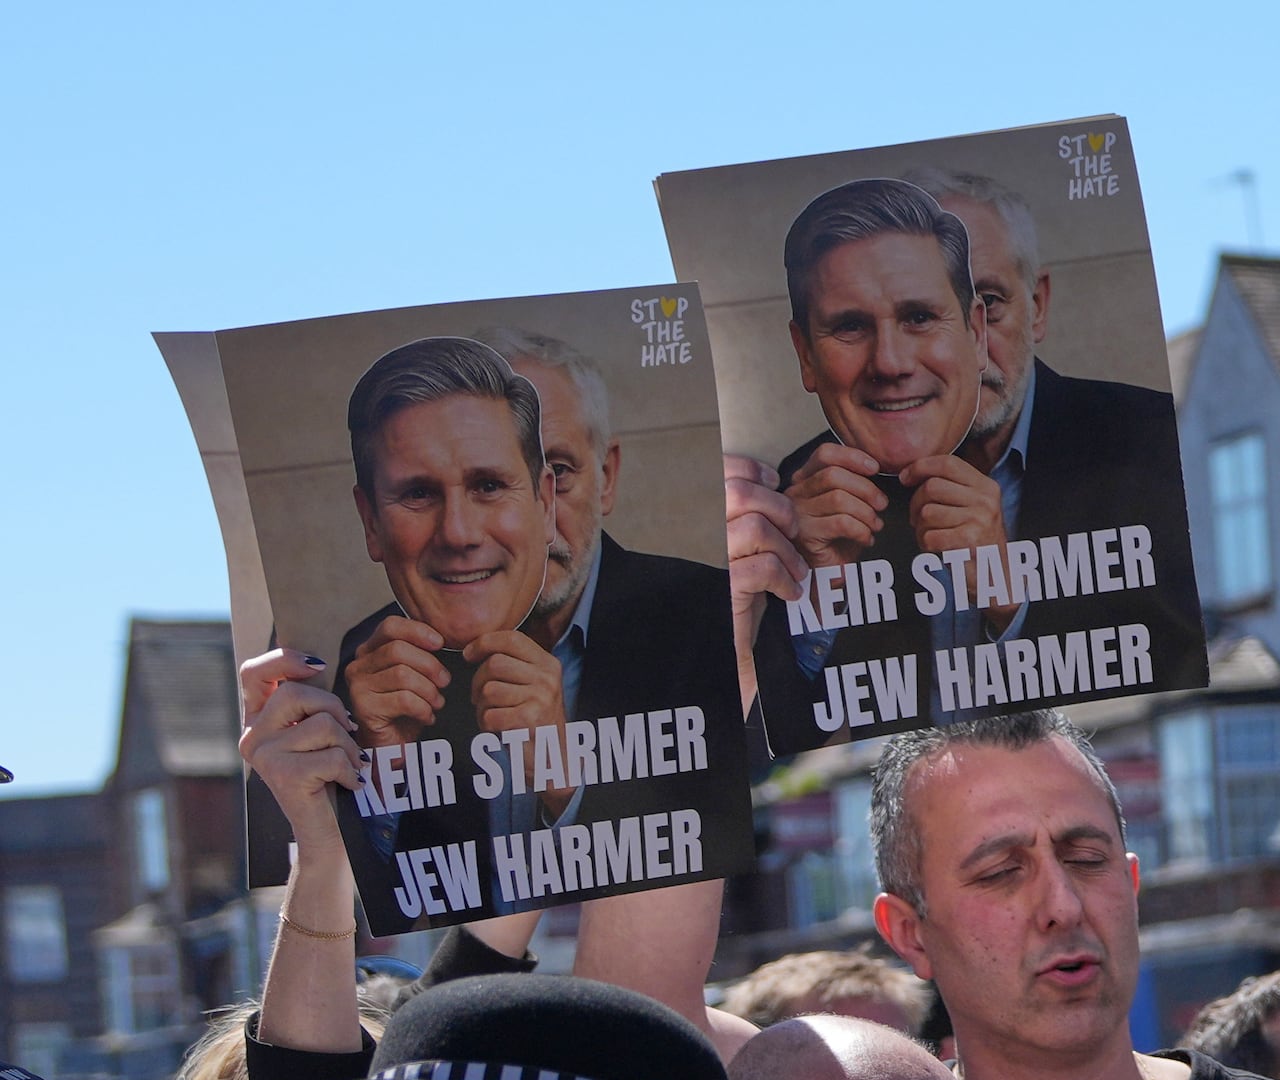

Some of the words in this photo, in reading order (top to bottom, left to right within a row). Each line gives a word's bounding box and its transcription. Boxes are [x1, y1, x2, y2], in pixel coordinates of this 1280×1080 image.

[1068, 154, 1113, 177] THE
[1068, 174, 1120, 201] HATE
[640, 320, 685, 343] THE
[640, 342, 693, 368] HATE
[911, 524, 1157, 617] STARMER
[812, 653, 918, 733] JEW
[935, 623, 1155, 714] HARMER
[470, 705, 709, 800] STARMER
[393, 840, 483, 920] JEW
[493, 807, 704, 904] HARMER
